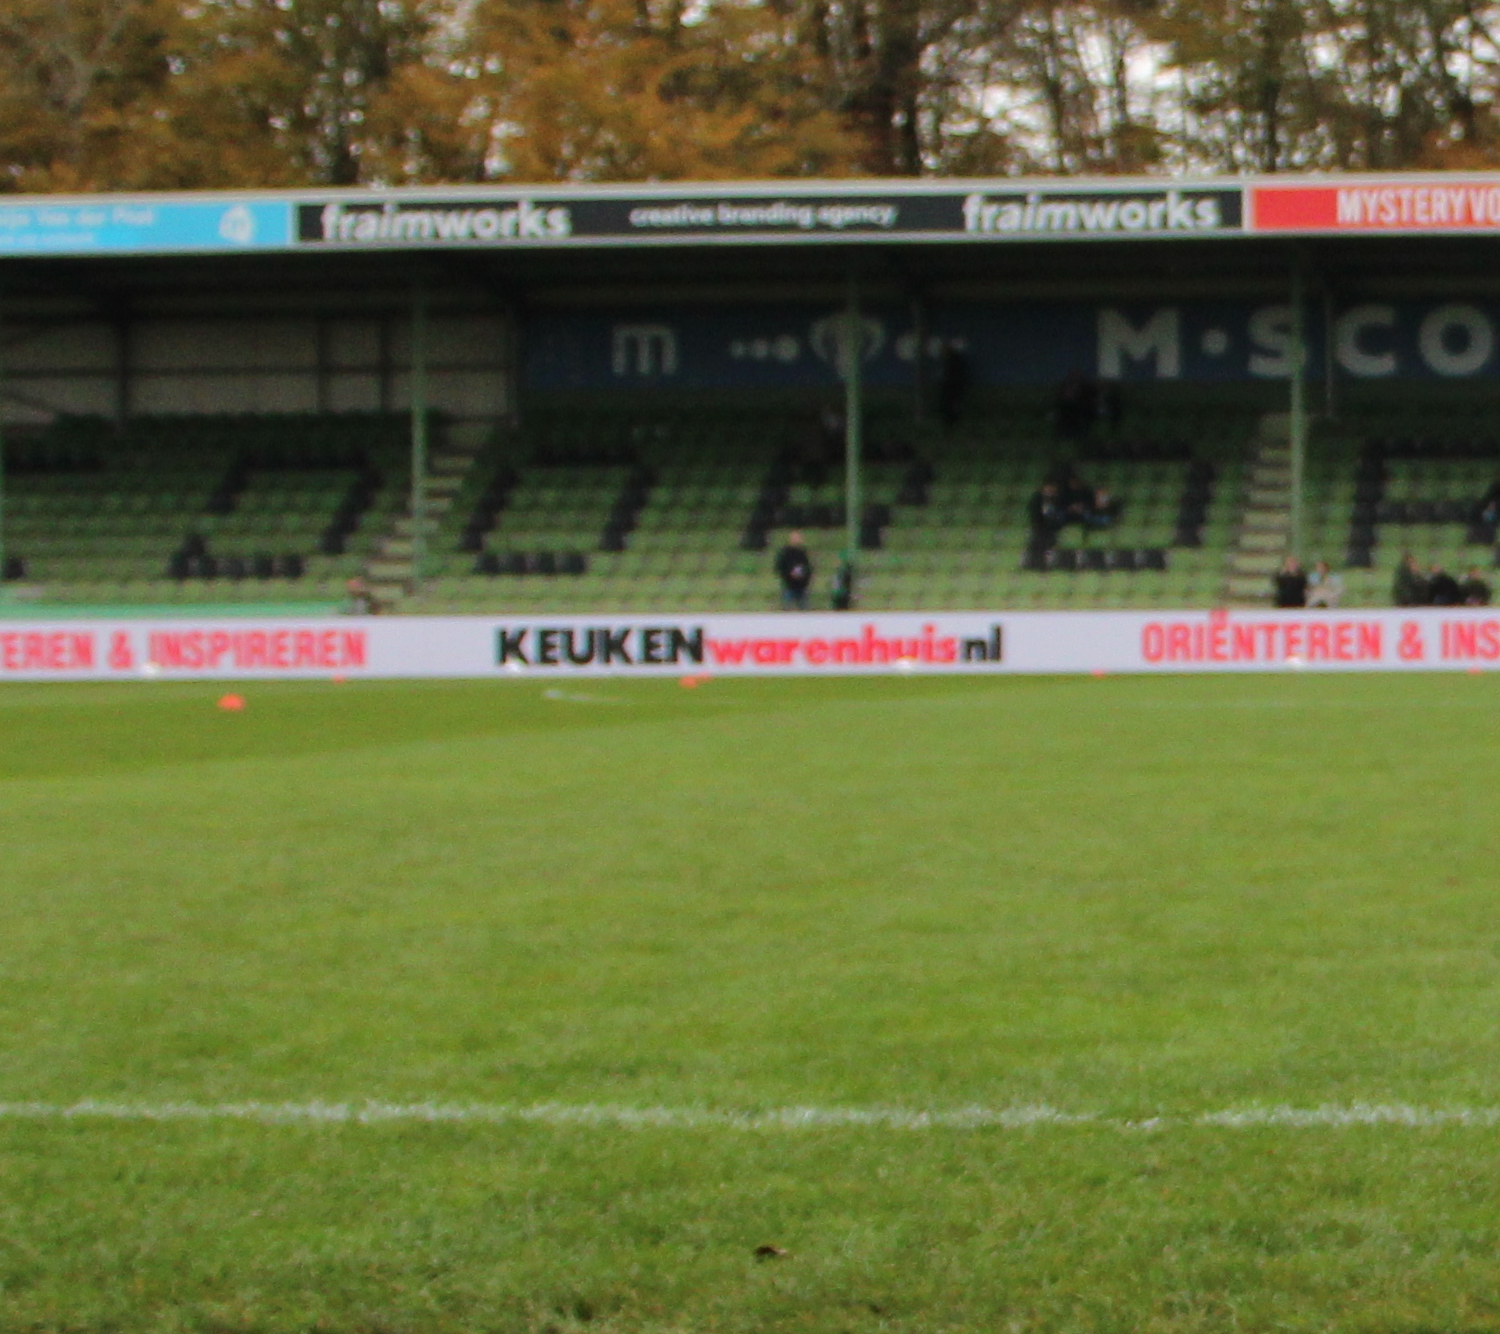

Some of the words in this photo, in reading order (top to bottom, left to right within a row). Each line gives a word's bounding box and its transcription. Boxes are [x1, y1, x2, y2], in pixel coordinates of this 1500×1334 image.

[321, 199, 572, 243] fraimworks
[962, 189, 1220, 232] fraimworks
[108, 631, 132, 670] &
[147, 630, 366, 668] INSPIREREN
[1141, 608, 1382, 663] ORIËNTEREN
[1398, 621, 1425, 661] &
